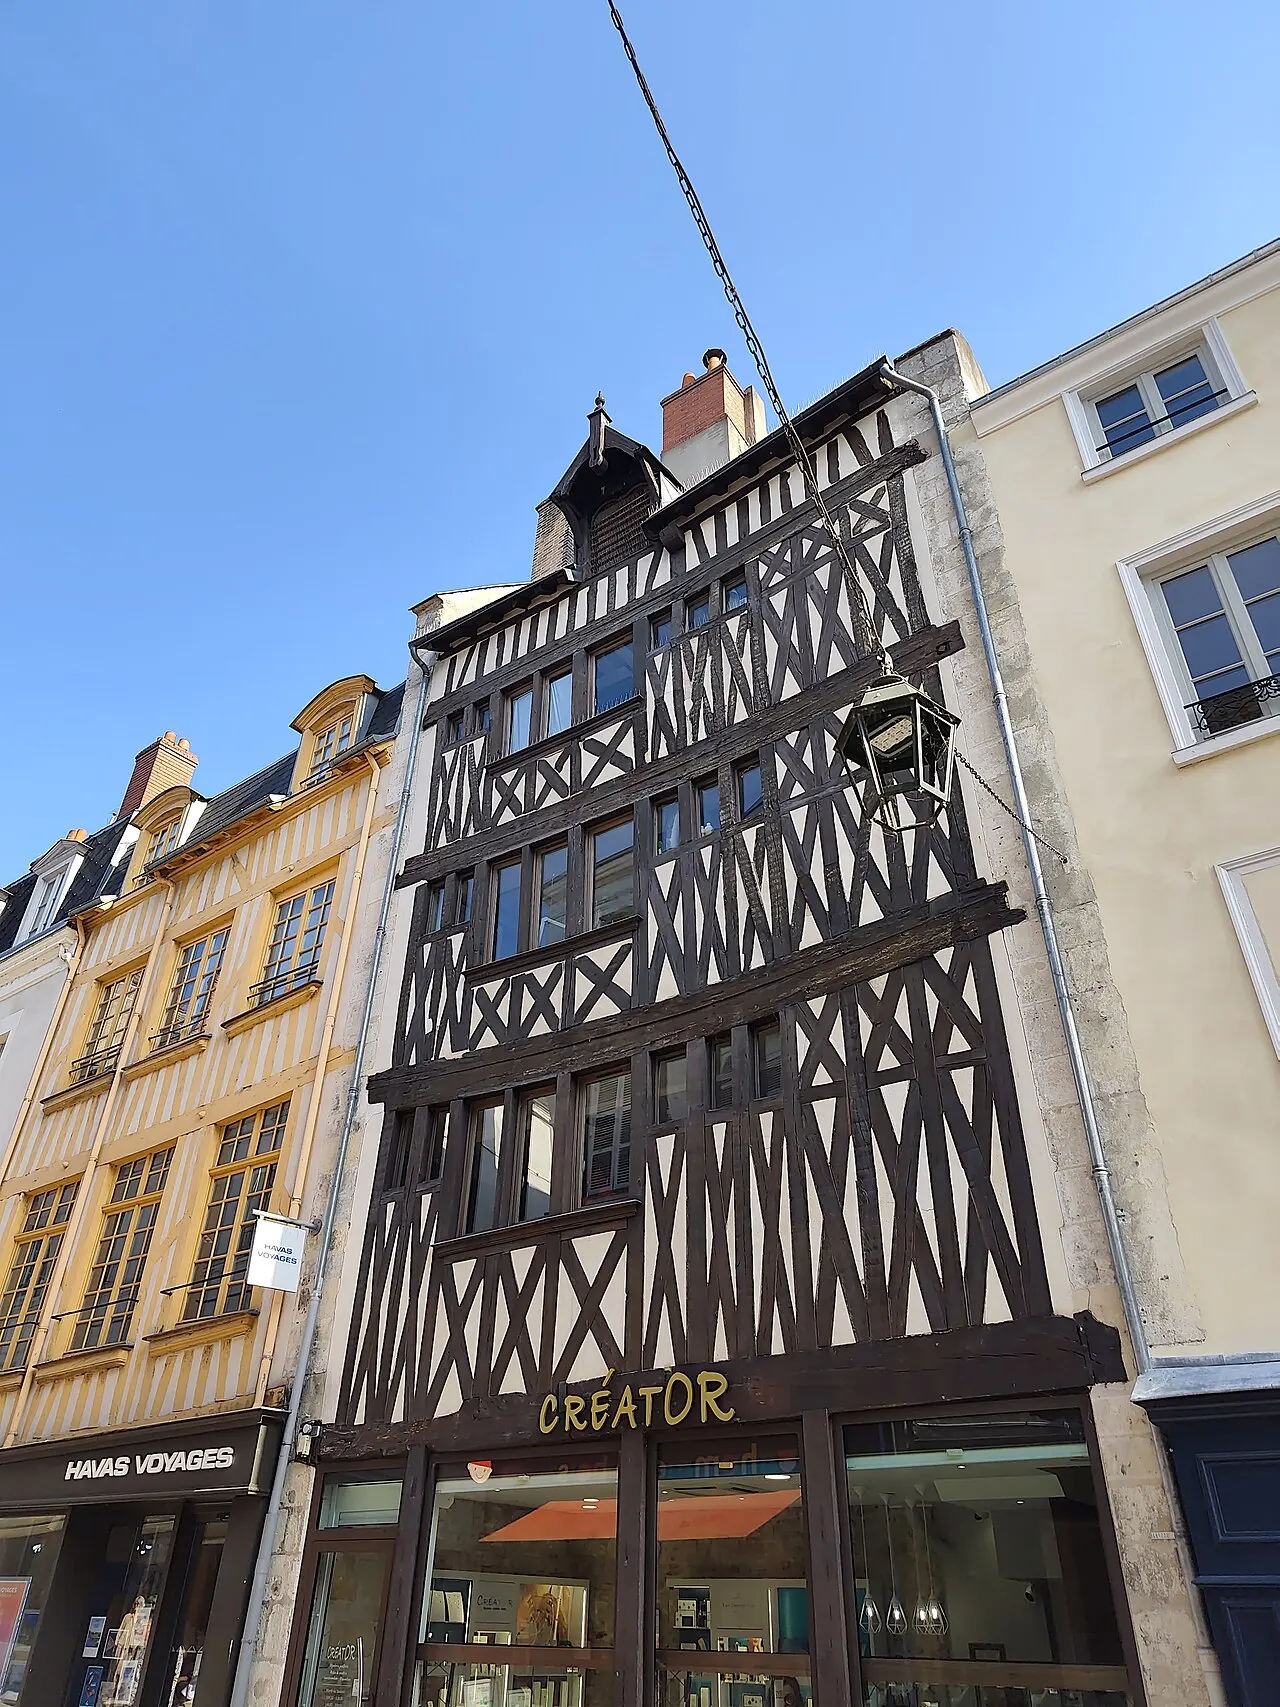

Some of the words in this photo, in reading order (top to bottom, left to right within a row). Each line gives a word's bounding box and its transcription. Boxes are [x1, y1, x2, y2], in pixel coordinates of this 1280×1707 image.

[257, 1250, 297, 1264] VOYAGES
[264, 1243, 293, 1254] HAVAS
[539, 1368, 736, 1434] CRÉATOR
[65, 1457, 131, 1480] HAVAS
[135, 1446, 234, 1475] VOYAGES
